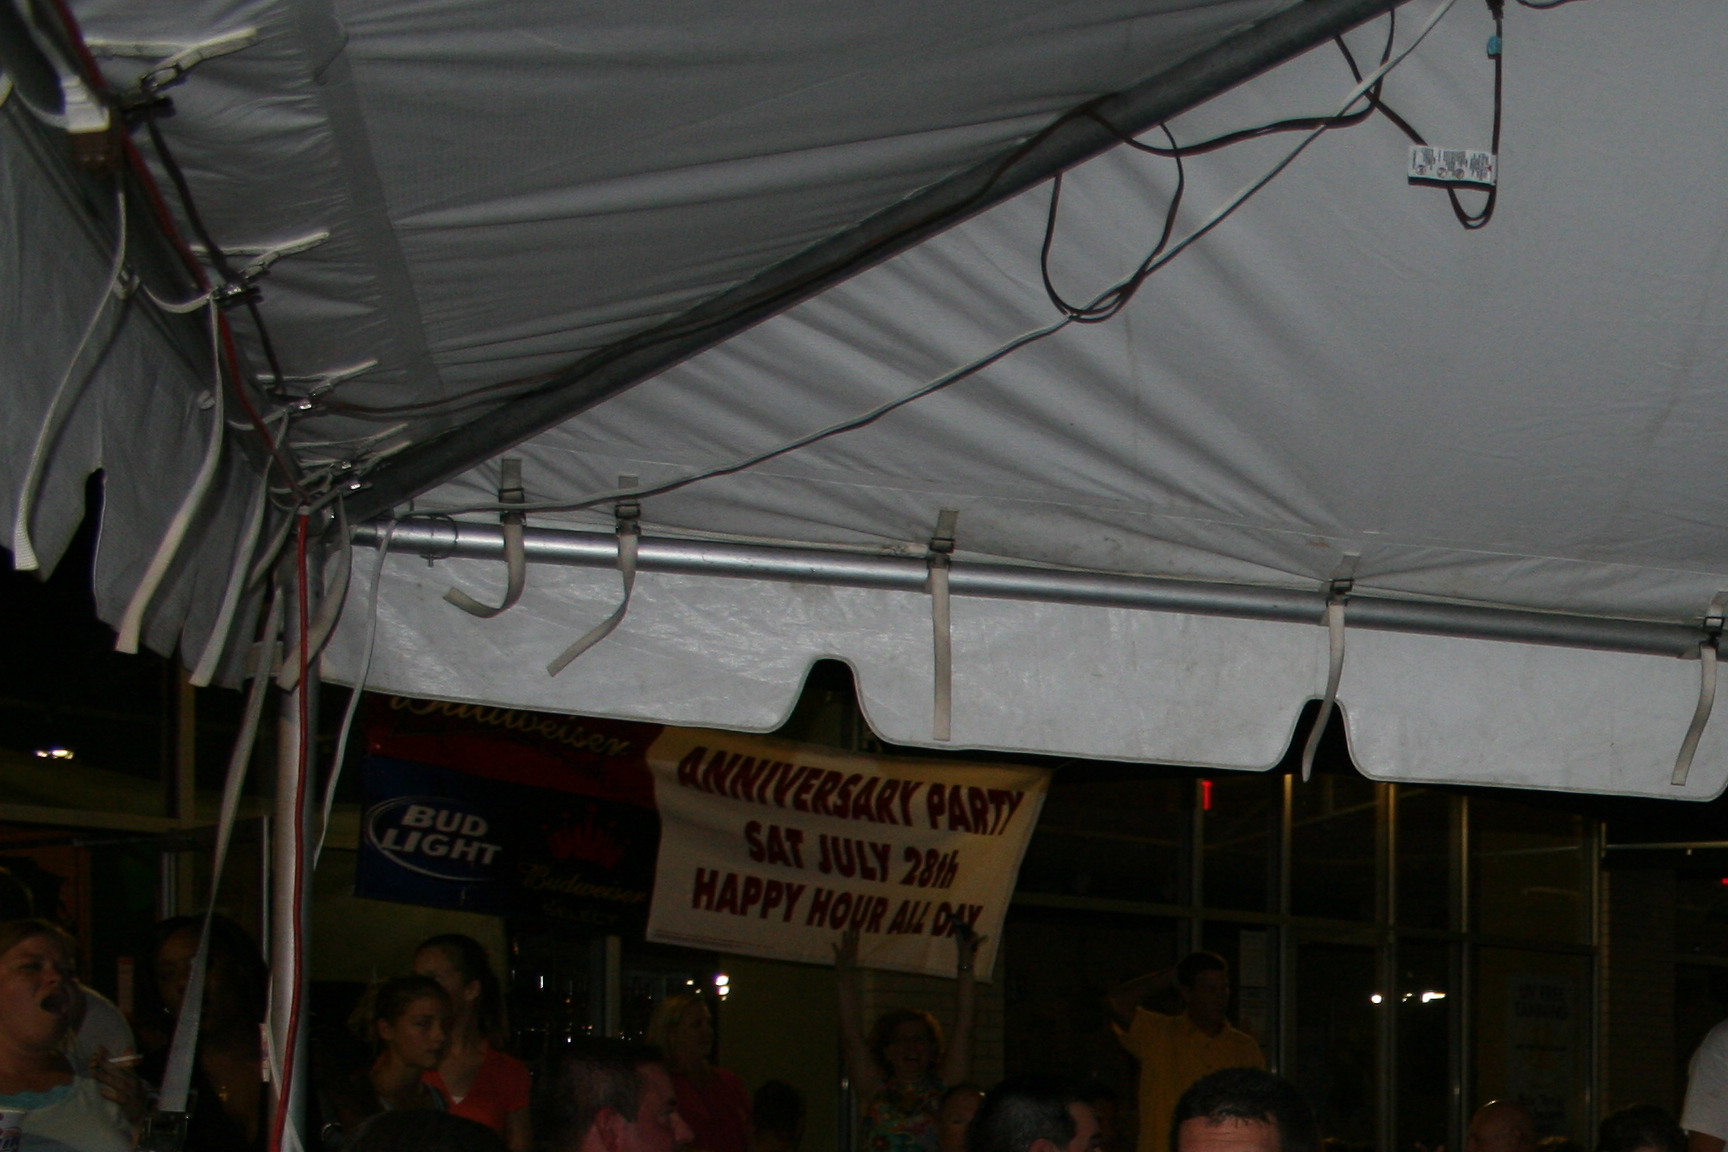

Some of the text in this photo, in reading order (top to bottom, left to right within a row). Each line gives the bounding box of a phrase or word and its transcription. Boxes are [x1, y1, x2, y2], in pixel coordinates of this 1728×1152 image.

[677, 746, 1025, 836] ANNIVERSARY PARTY
[381, 827, 502, 866] LIGHT
[400, 804, 489, 838] BUD
[744, 820, 960, 889] SAT JULY 28th
[518, 862, 647, 903] Budweiser
[691, 867, 807, 923] HAPPY
[806, 887, 889, 934] HOUR
[886, 899, 932, 935] ALL
